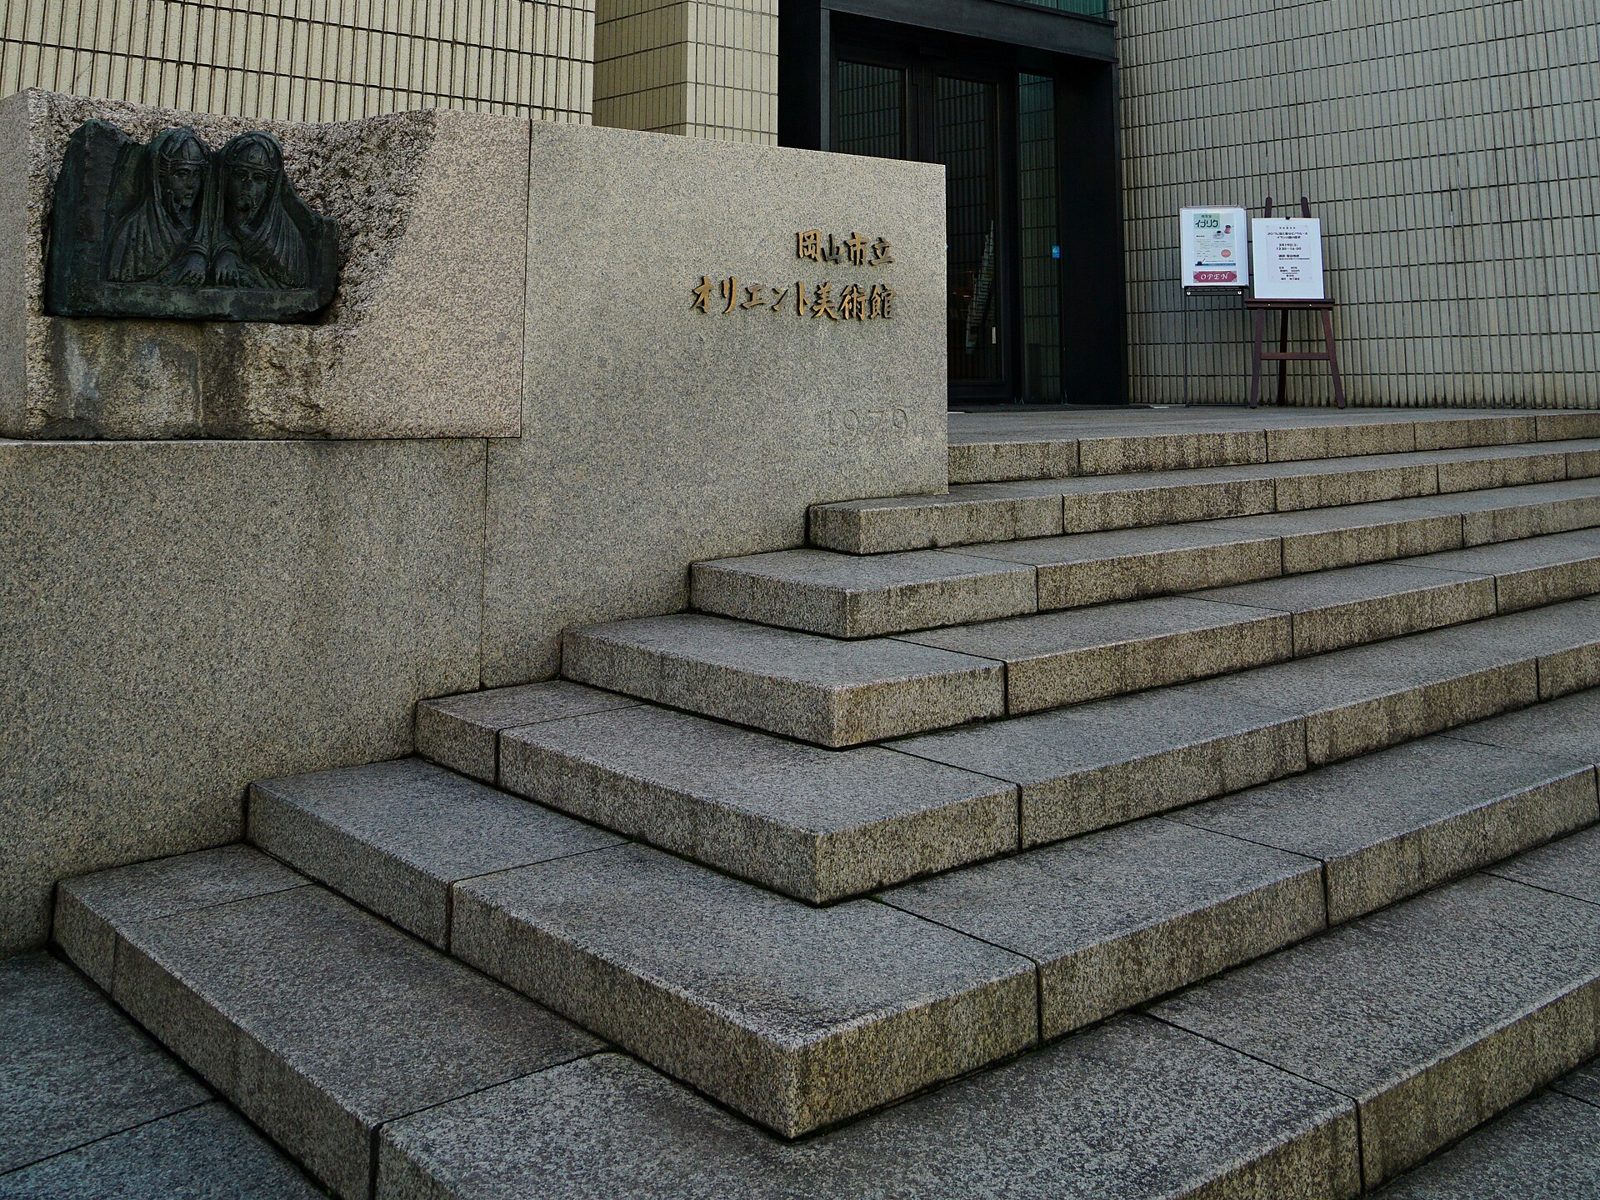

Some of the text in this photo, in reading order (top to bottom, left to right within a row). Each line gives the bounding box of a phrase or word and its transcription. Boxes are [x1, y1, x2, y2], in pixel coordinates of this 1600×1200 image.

[796, 229, 895, 266] 岡山市立
[1200, 272, 1229, 281] OPEN
[690, 275, 896, 321] オリエント美術館
